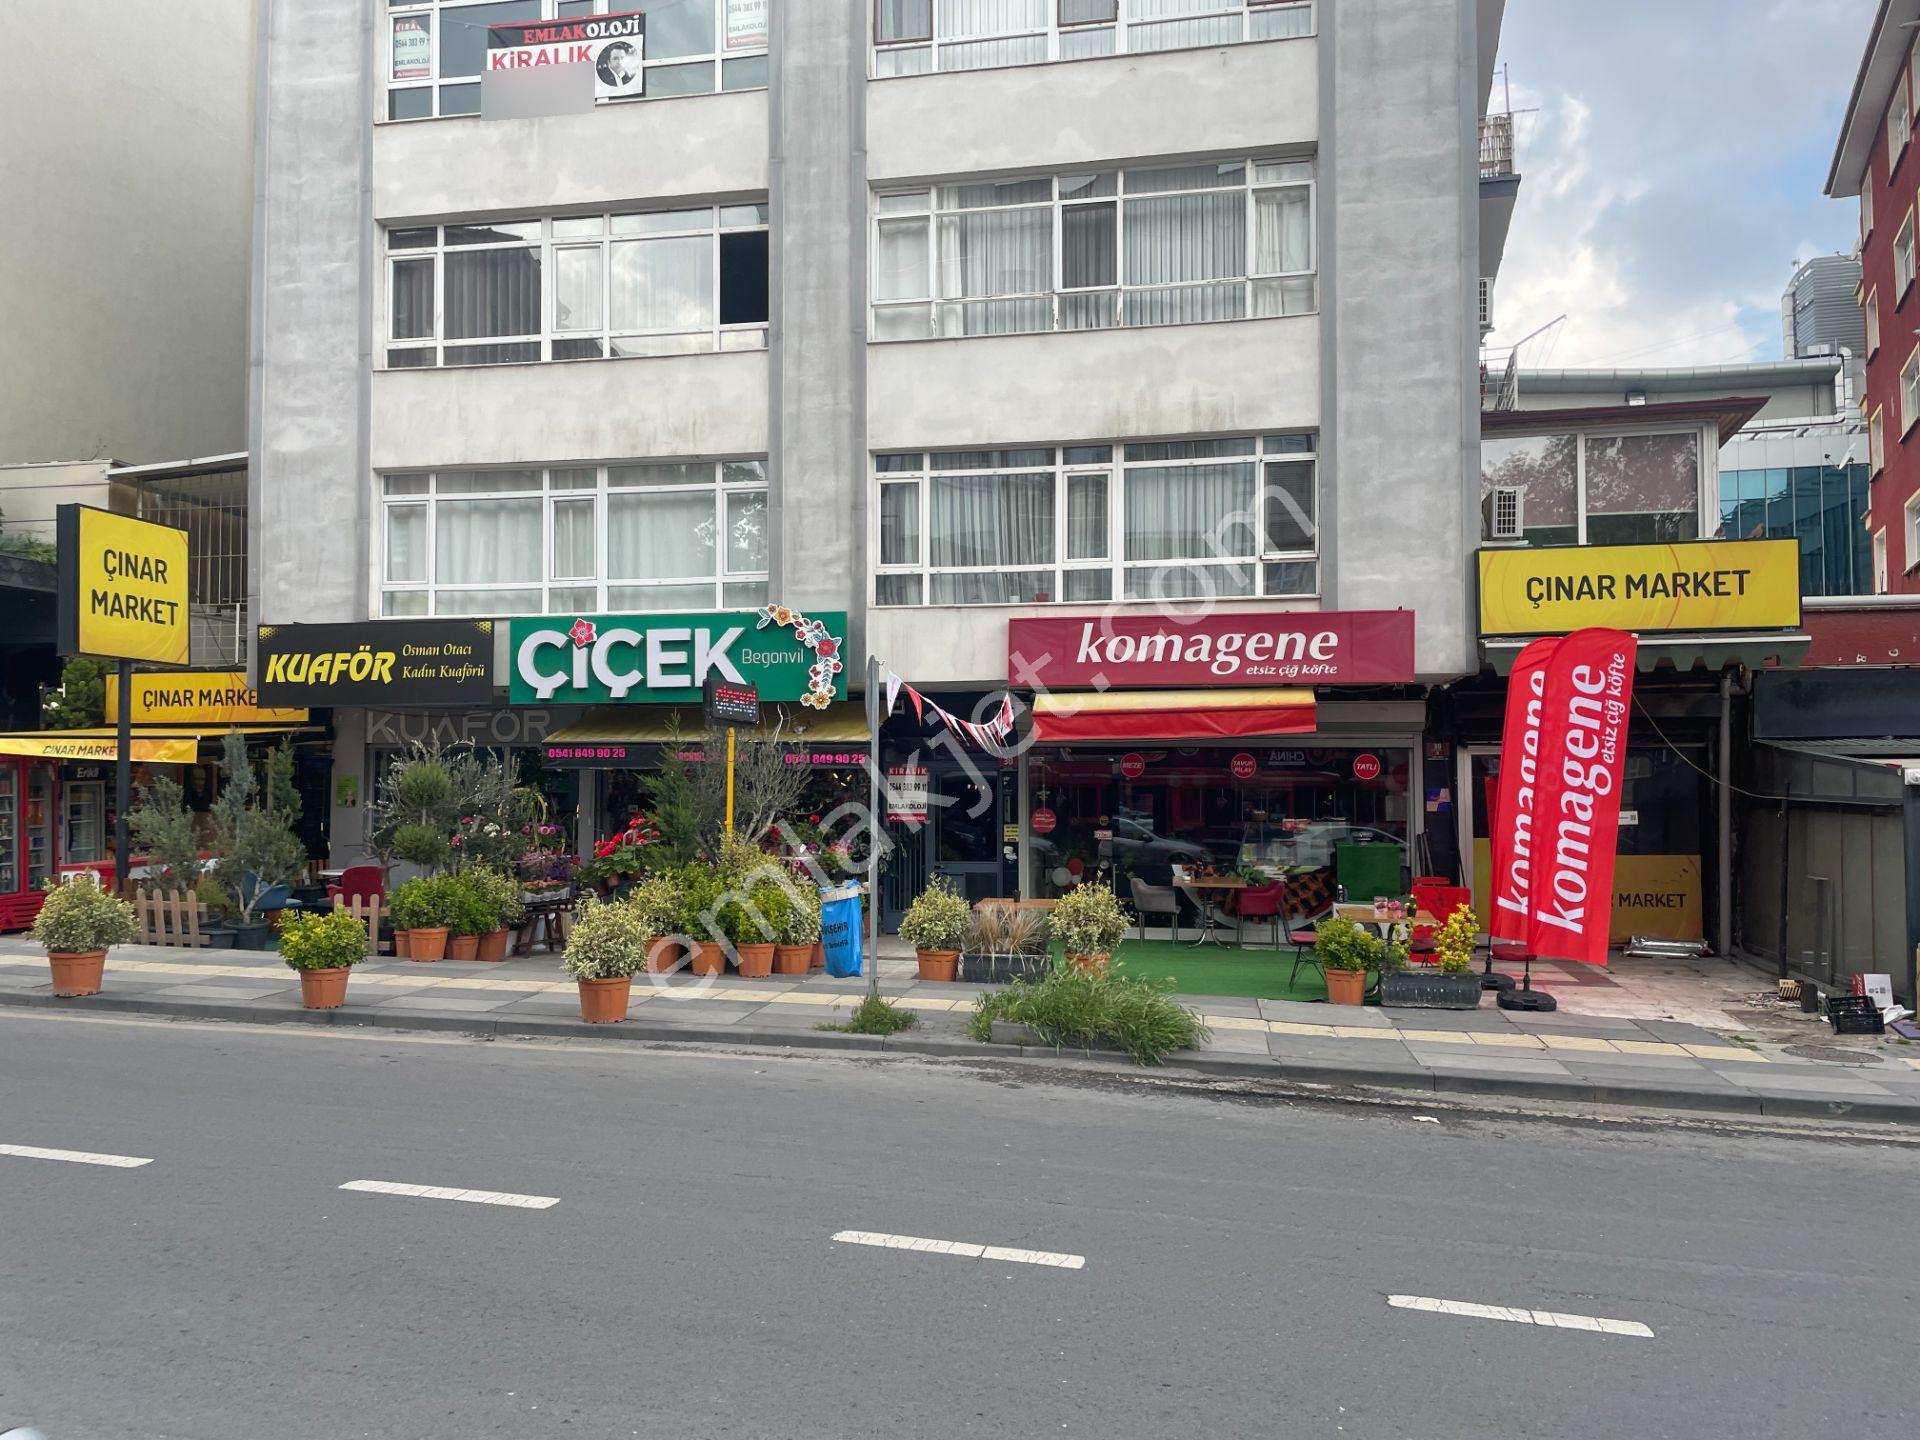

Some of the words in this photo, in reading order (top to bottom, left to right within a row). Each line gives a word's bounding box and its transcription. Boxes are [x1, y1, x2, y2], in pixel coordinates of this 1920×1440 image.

[524, 15, 639, 44] EMLAKOLOJİ
[104, 549, 167, 584] ÇINAR
[1526, 574, 1616, 609] ÇINAR
[1625, 570, 1751, 599] MARKET
[91, 589, 179, 626] MARKET
[265, 645, 396, 686] KUAFÖR
[402, 644, 440, 656] Osman
[443, 643, 472, 655] Otacı
[517, 625, 749, 698] ÇİÇEK
[742, 647, 804, 669] Begonvil
[1076, 622, 1339, 675] komagene
[402, 665, 436, 678] Kadın
[439, 662, 485, 683] Kuaförü
[1246, 665, 1276, 675] etsiz
[1278, 663, 1299, 677] çiğ
[1301, 663, 1338, 675] köfte
[1605, 653, 1627, 698] köfte
[143, 689, 194, 713] ÇINAR
[198, 689, 258, 707] MARKE
[1605, 699, 1626, 725] çiğ
[368, 709, 550, 743] KUAFÖR
[548, 748, 573, 758] 0541
[575, 748, 594, 758] 849
[597, 748, 610, 758] 90
[612, 748, 626, 758] 25
[812, 754, 833, 764] 849
[835, 754, 849, 764] 90
[851, 754, 866, 764] 25
[1603, 726, 1619, 765] etsiz
[1536, 664, 1613, 935] komagene
[1618, 893, 1687, 908] MARKET
